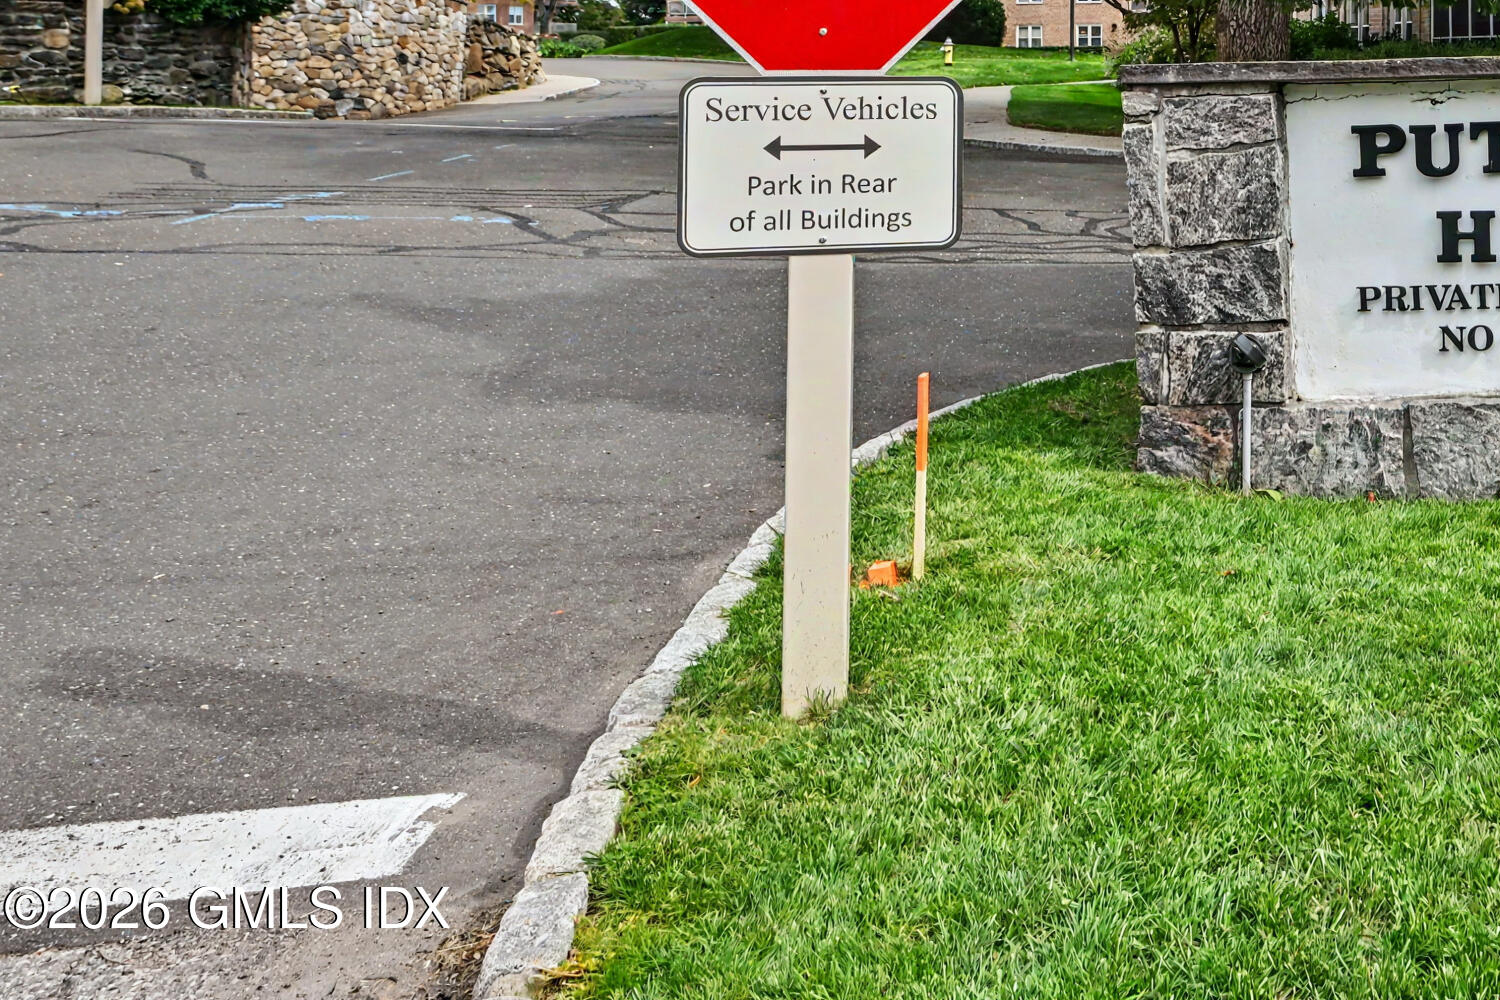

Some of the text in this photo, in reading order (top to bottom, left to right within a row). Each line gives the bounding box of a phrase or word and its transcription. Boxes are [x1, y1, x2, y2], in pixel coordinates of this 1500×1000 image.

[705, 96, 938, 123] Service Vehicles
[748, 175, 897, 196] Park in Rear
[729, 208, 912, 232] of all Buildings
[1439, 325, 1494, 352] NO
